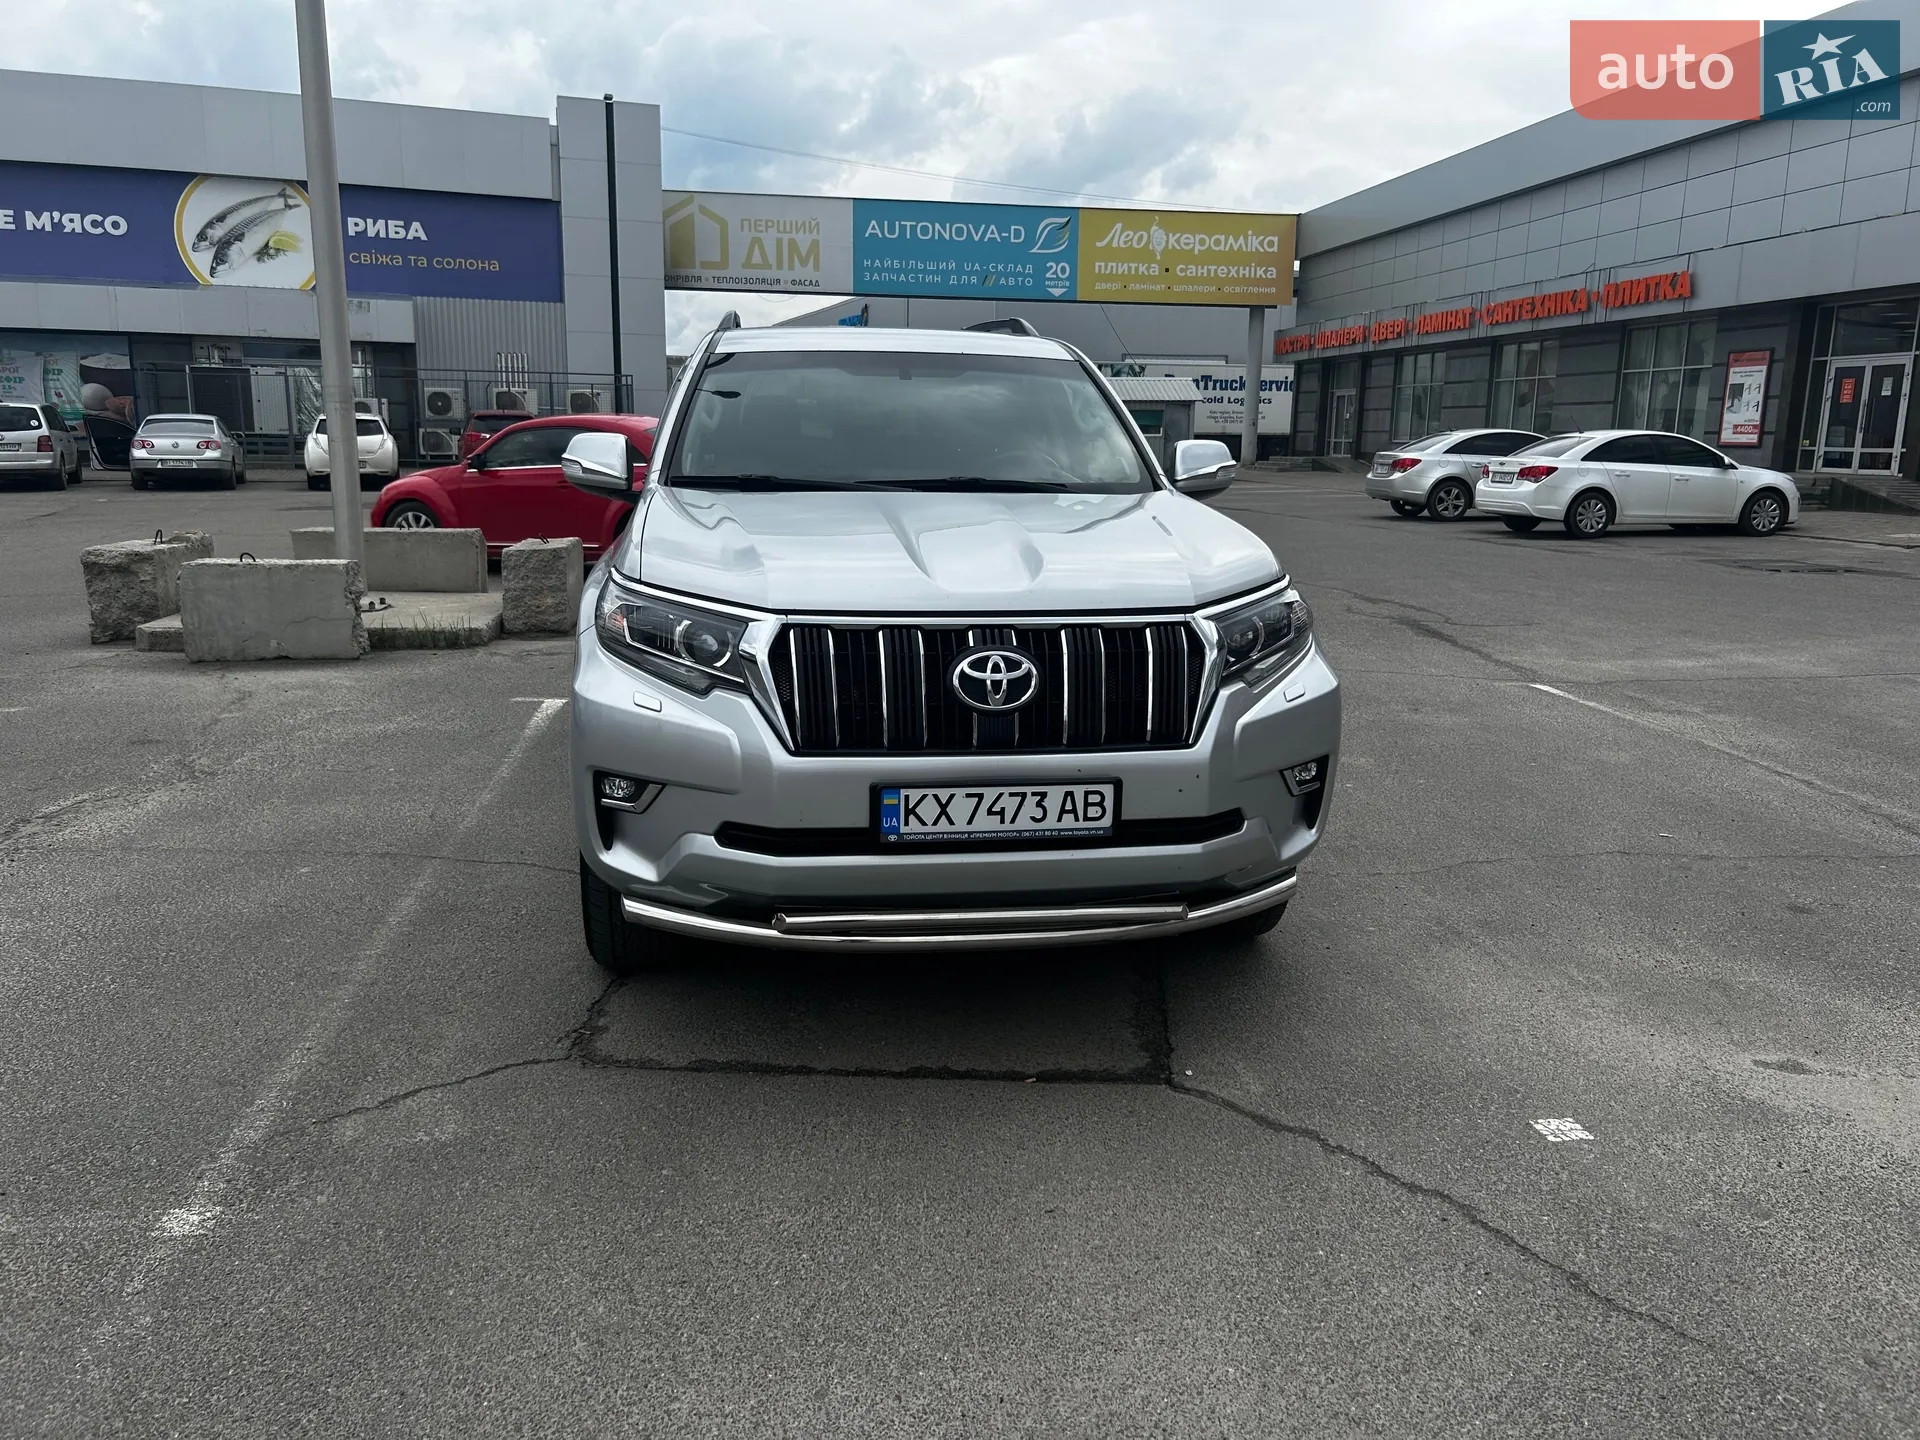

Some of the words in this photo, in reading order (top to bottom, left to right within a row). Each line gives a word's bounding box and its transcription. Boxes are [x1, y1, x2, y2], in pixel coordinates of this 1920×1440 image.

[347, 217, 428, 241] РИБА
[740, 216, 820, 235] ПЕРШИЙ
[864, 219, 1025, 243] AUTONOVA-D
[1095, 222, 1148, 248] Лео
[1168, 230, 1279, 255] кераміка
[349, 249, 402, 266] свіжа
[407, 255, 428, 267] та
[433, 256, 500, 271] солона
[741, 236, 821, 272] ДІМ
[863, 257, 956, 271] НАЙБІЛЬШИЙ
[1045, 262, 1070, 279] 20
[1094, 261, 1159, 276] плитка
[1176, 263, 1277, 279] сантехніка
[664, 274, 702, 283] ОКРІВЛЯ
[711, 275, 781, 287] ТЕПЛОІЗОЛЯЦІЯ
[790, 279, 821, 287] ФАСАД
[863, 272, 942, 283] ЗАПЧАСТИН
[949, 275, 977, 285] ДЛЯ
[999, 277, 1033, 286] АВТО
[1045, 279, 1070, 288] метрів
[1094, 281, 1121, 291] двері
[1129, 282, 1165, 291] ламінат
[1173, 284, 1216, 293] шпалери
[1223, 284, 1276, 293] освітлення
[1316, 324, 1365, 349] ШПАЛЕРИ
[1371, 317, 1407, 343] ДВЕРІ
[1416, 306, 1474, 335] ЛАМІНАТ
[1483, 288, 1588, 325] САНТЕХНІКА
[1602, 270, 1691, 308] ПЛИТКА
[883, 817, 898, 828] UA
